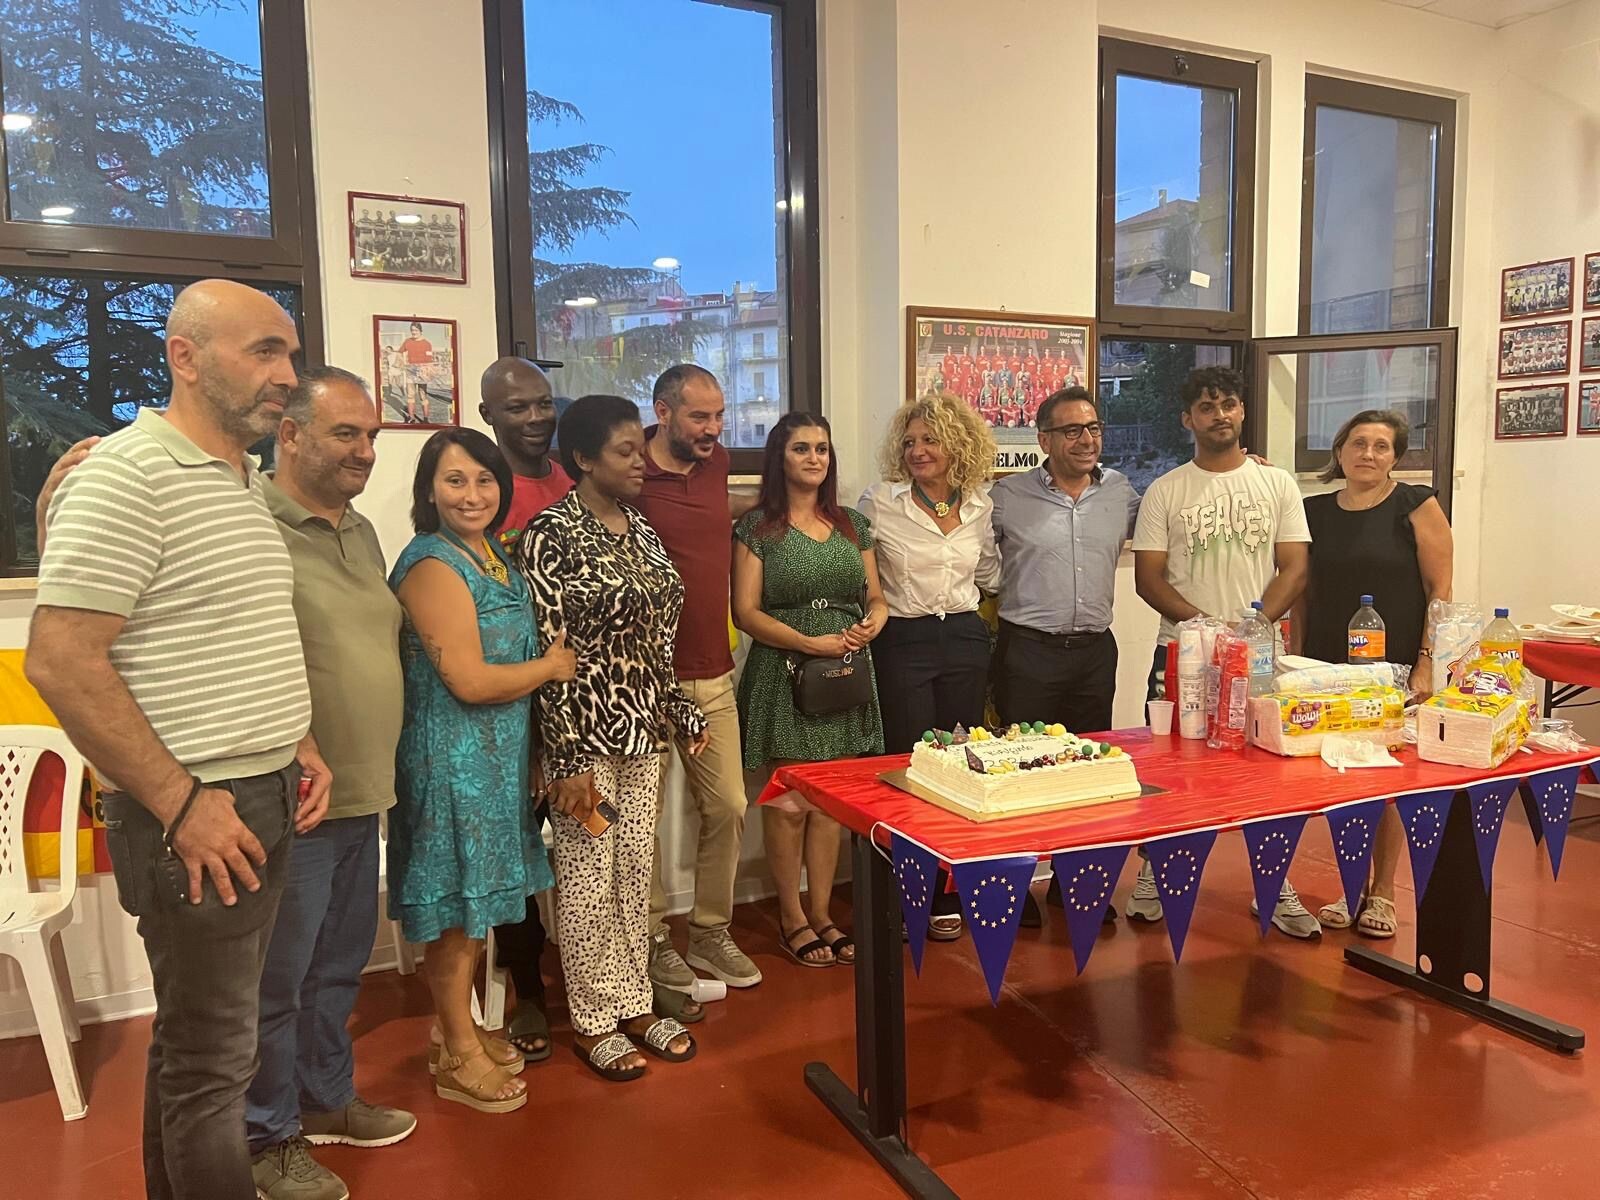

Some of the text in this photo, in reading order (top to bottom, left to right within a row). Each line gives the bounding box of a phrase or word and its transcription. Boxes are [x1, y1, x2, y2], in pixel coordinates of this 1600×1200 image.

[943, 324, 1049, 340] U.S. CATANZARO
[993, 452, 1039, 467] ELMO
[1180, 491, 1270, 554] PEACE!
[825, 666, 854, 678] MOSCHINO
